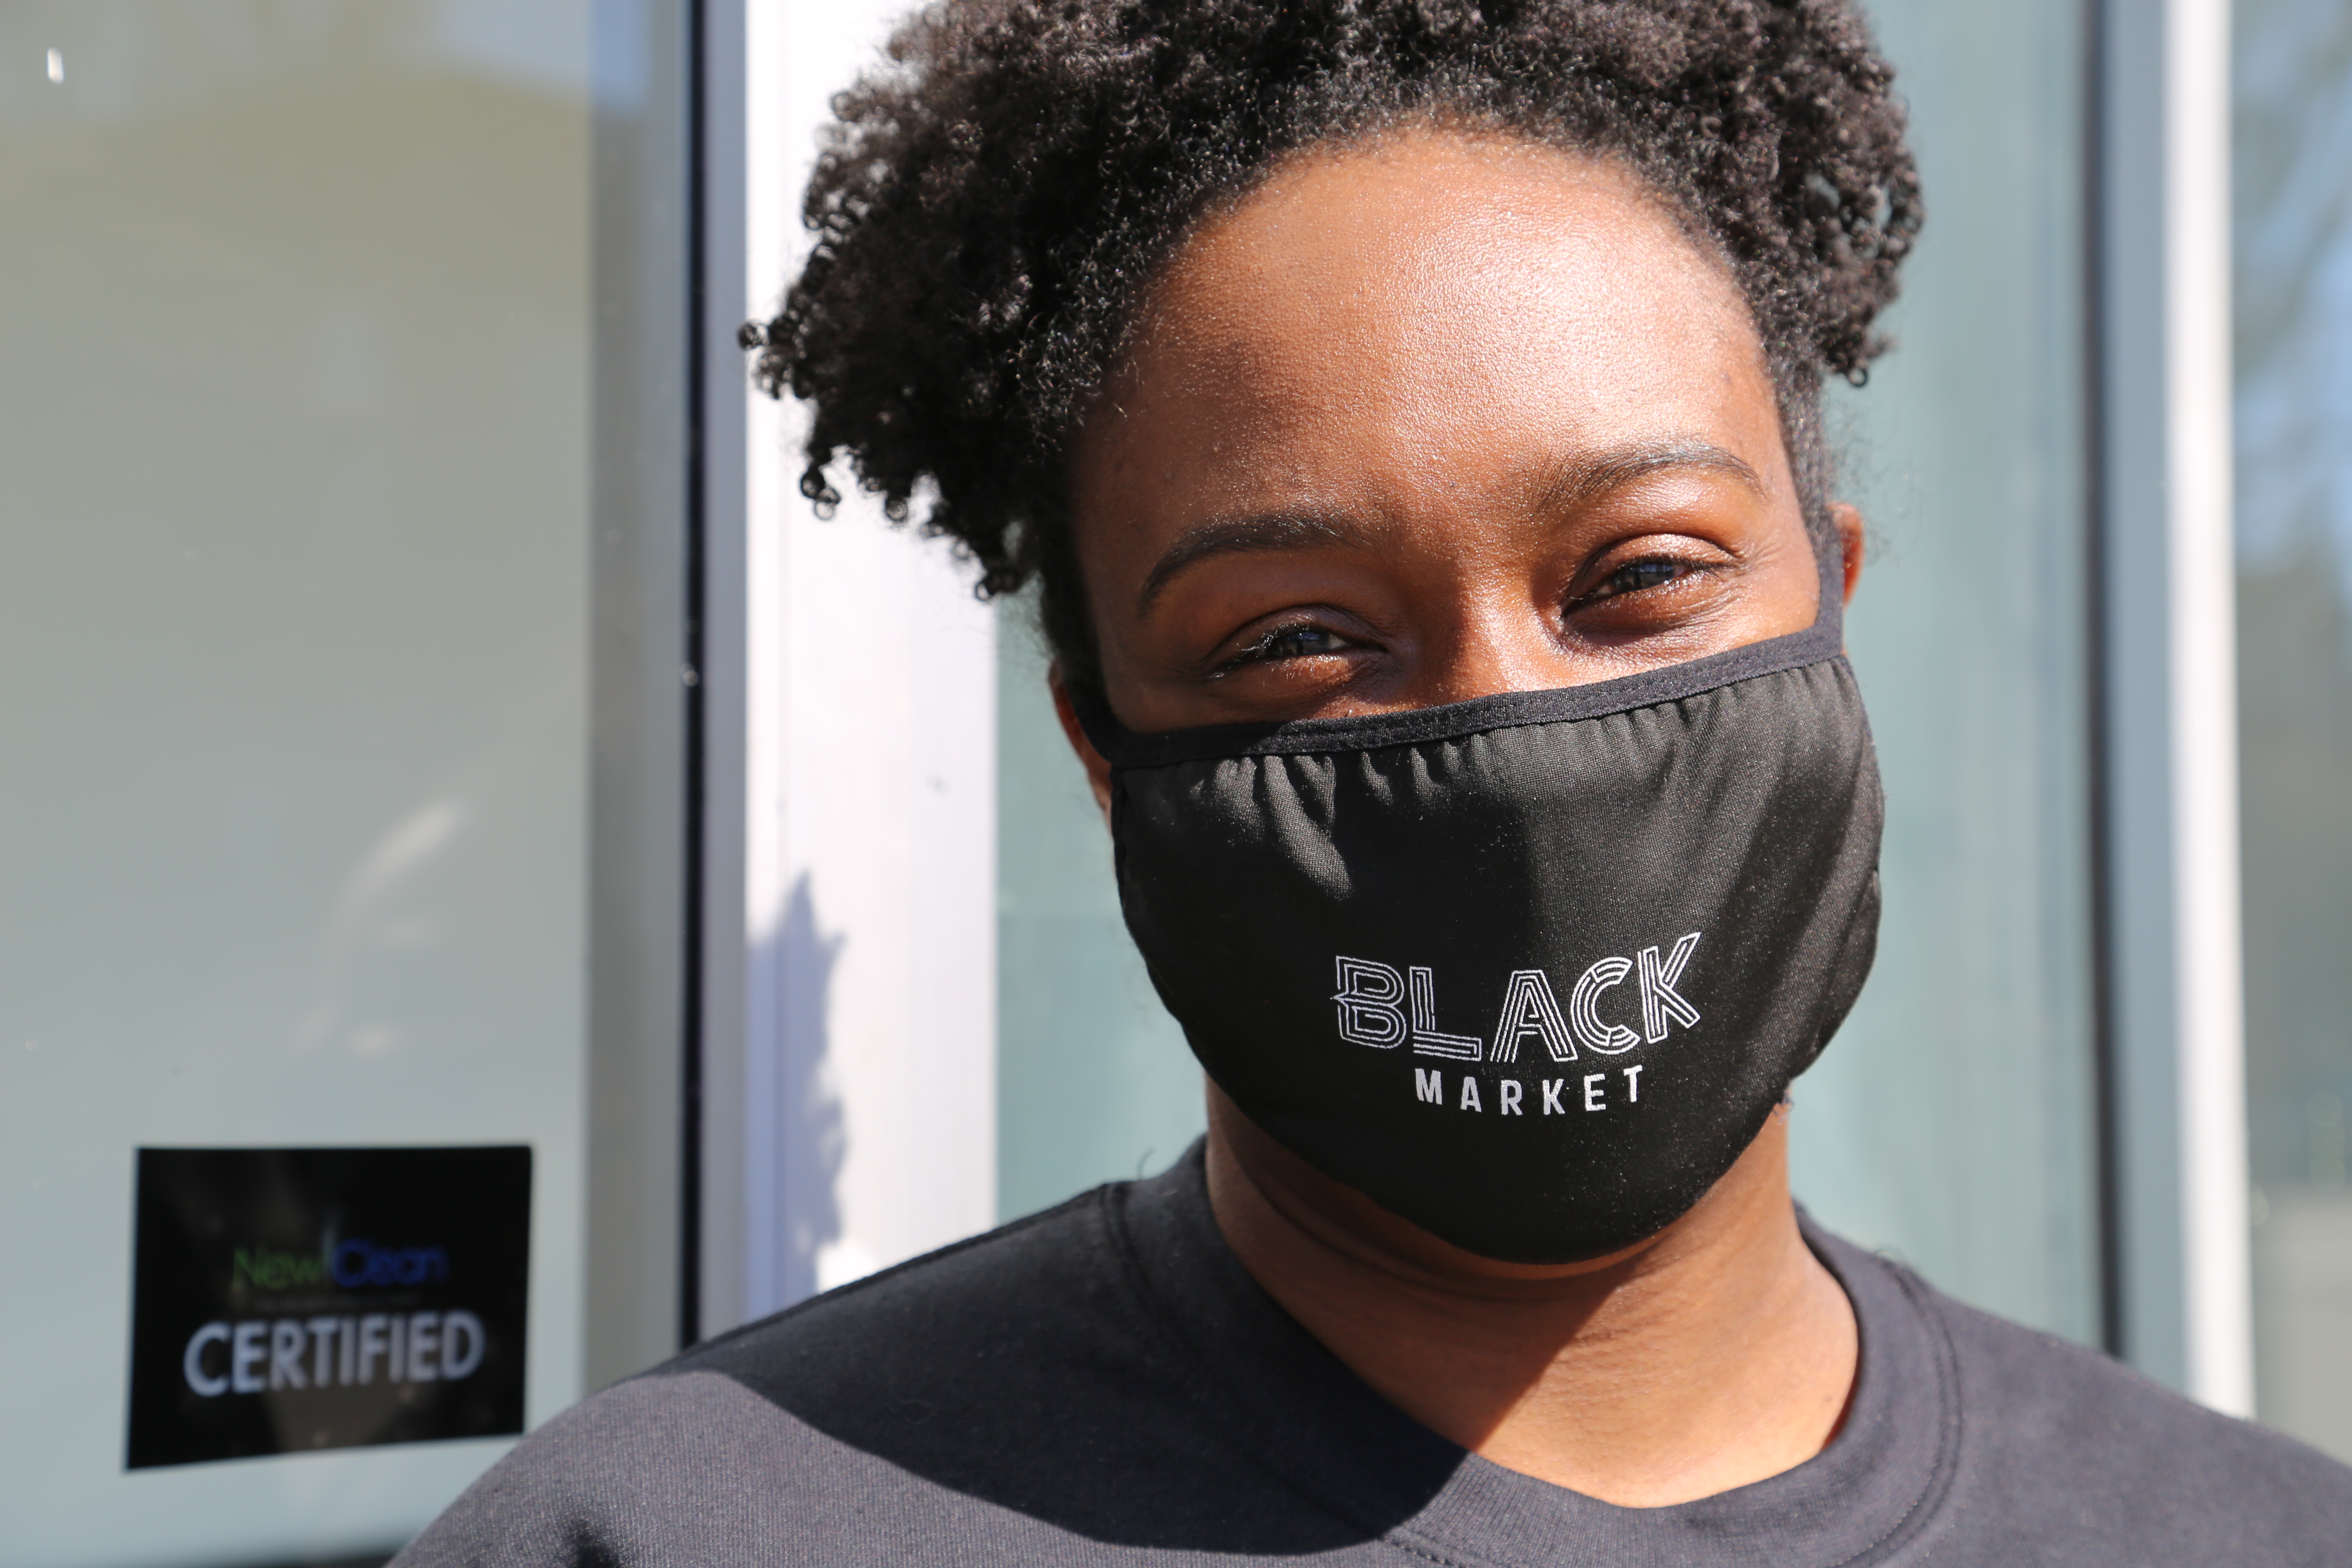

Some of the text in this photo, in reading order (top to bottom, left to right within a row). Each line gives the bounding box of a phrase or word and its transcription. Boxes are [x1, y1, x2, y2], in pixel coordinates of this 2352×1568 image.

[1330, 932, 1701, 1063] BLACK
[1415, 1065, 1643, 1116] MARKET
[183, 1311, 485, 1396] CERTIFIED
